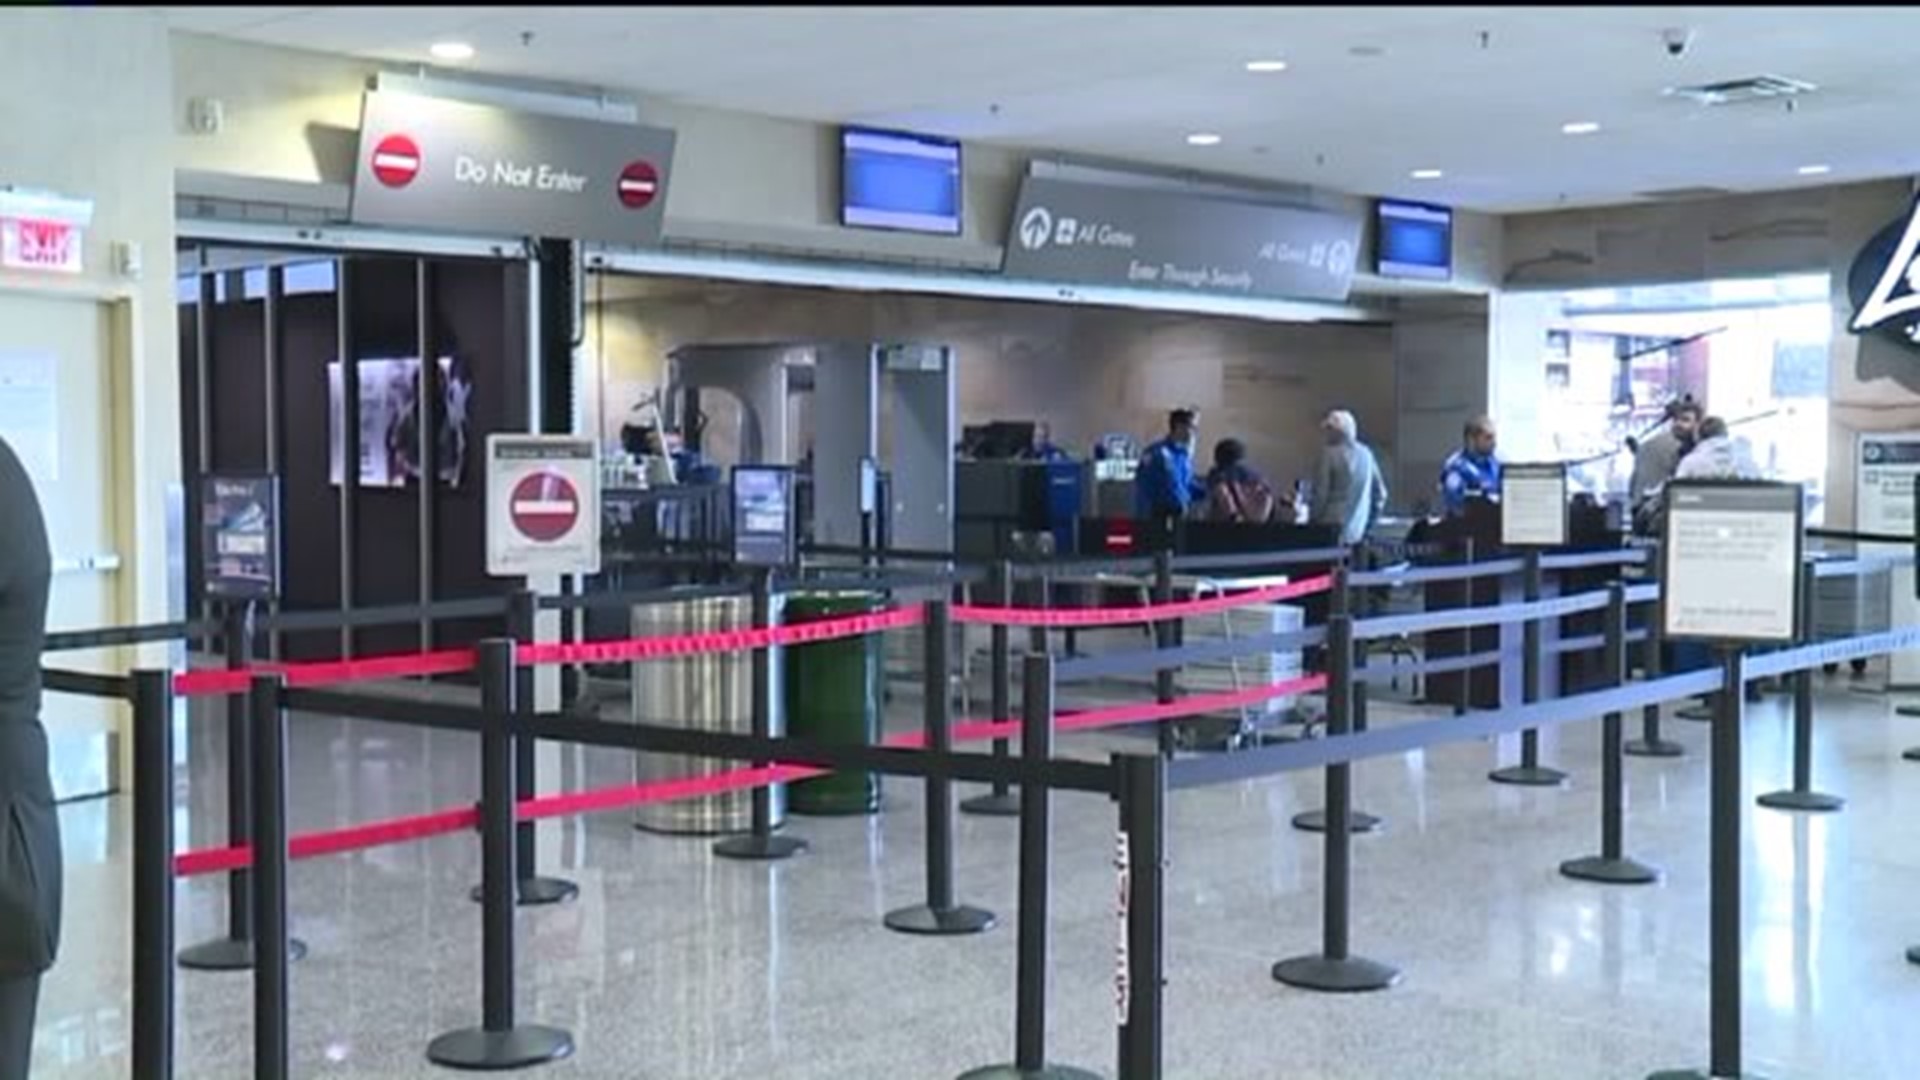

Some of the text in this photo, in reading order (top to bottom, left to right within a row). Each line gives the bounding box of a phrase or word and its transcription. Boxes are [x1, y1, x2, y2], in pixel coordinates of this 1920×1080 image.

[455, 156, 588, 192] Do Not Enter
[19, 220, 70, 264] EXIT
[1077, 223, 1135, 248] All Gates
[1128, 260, 1252, 290] Enter Through Security
